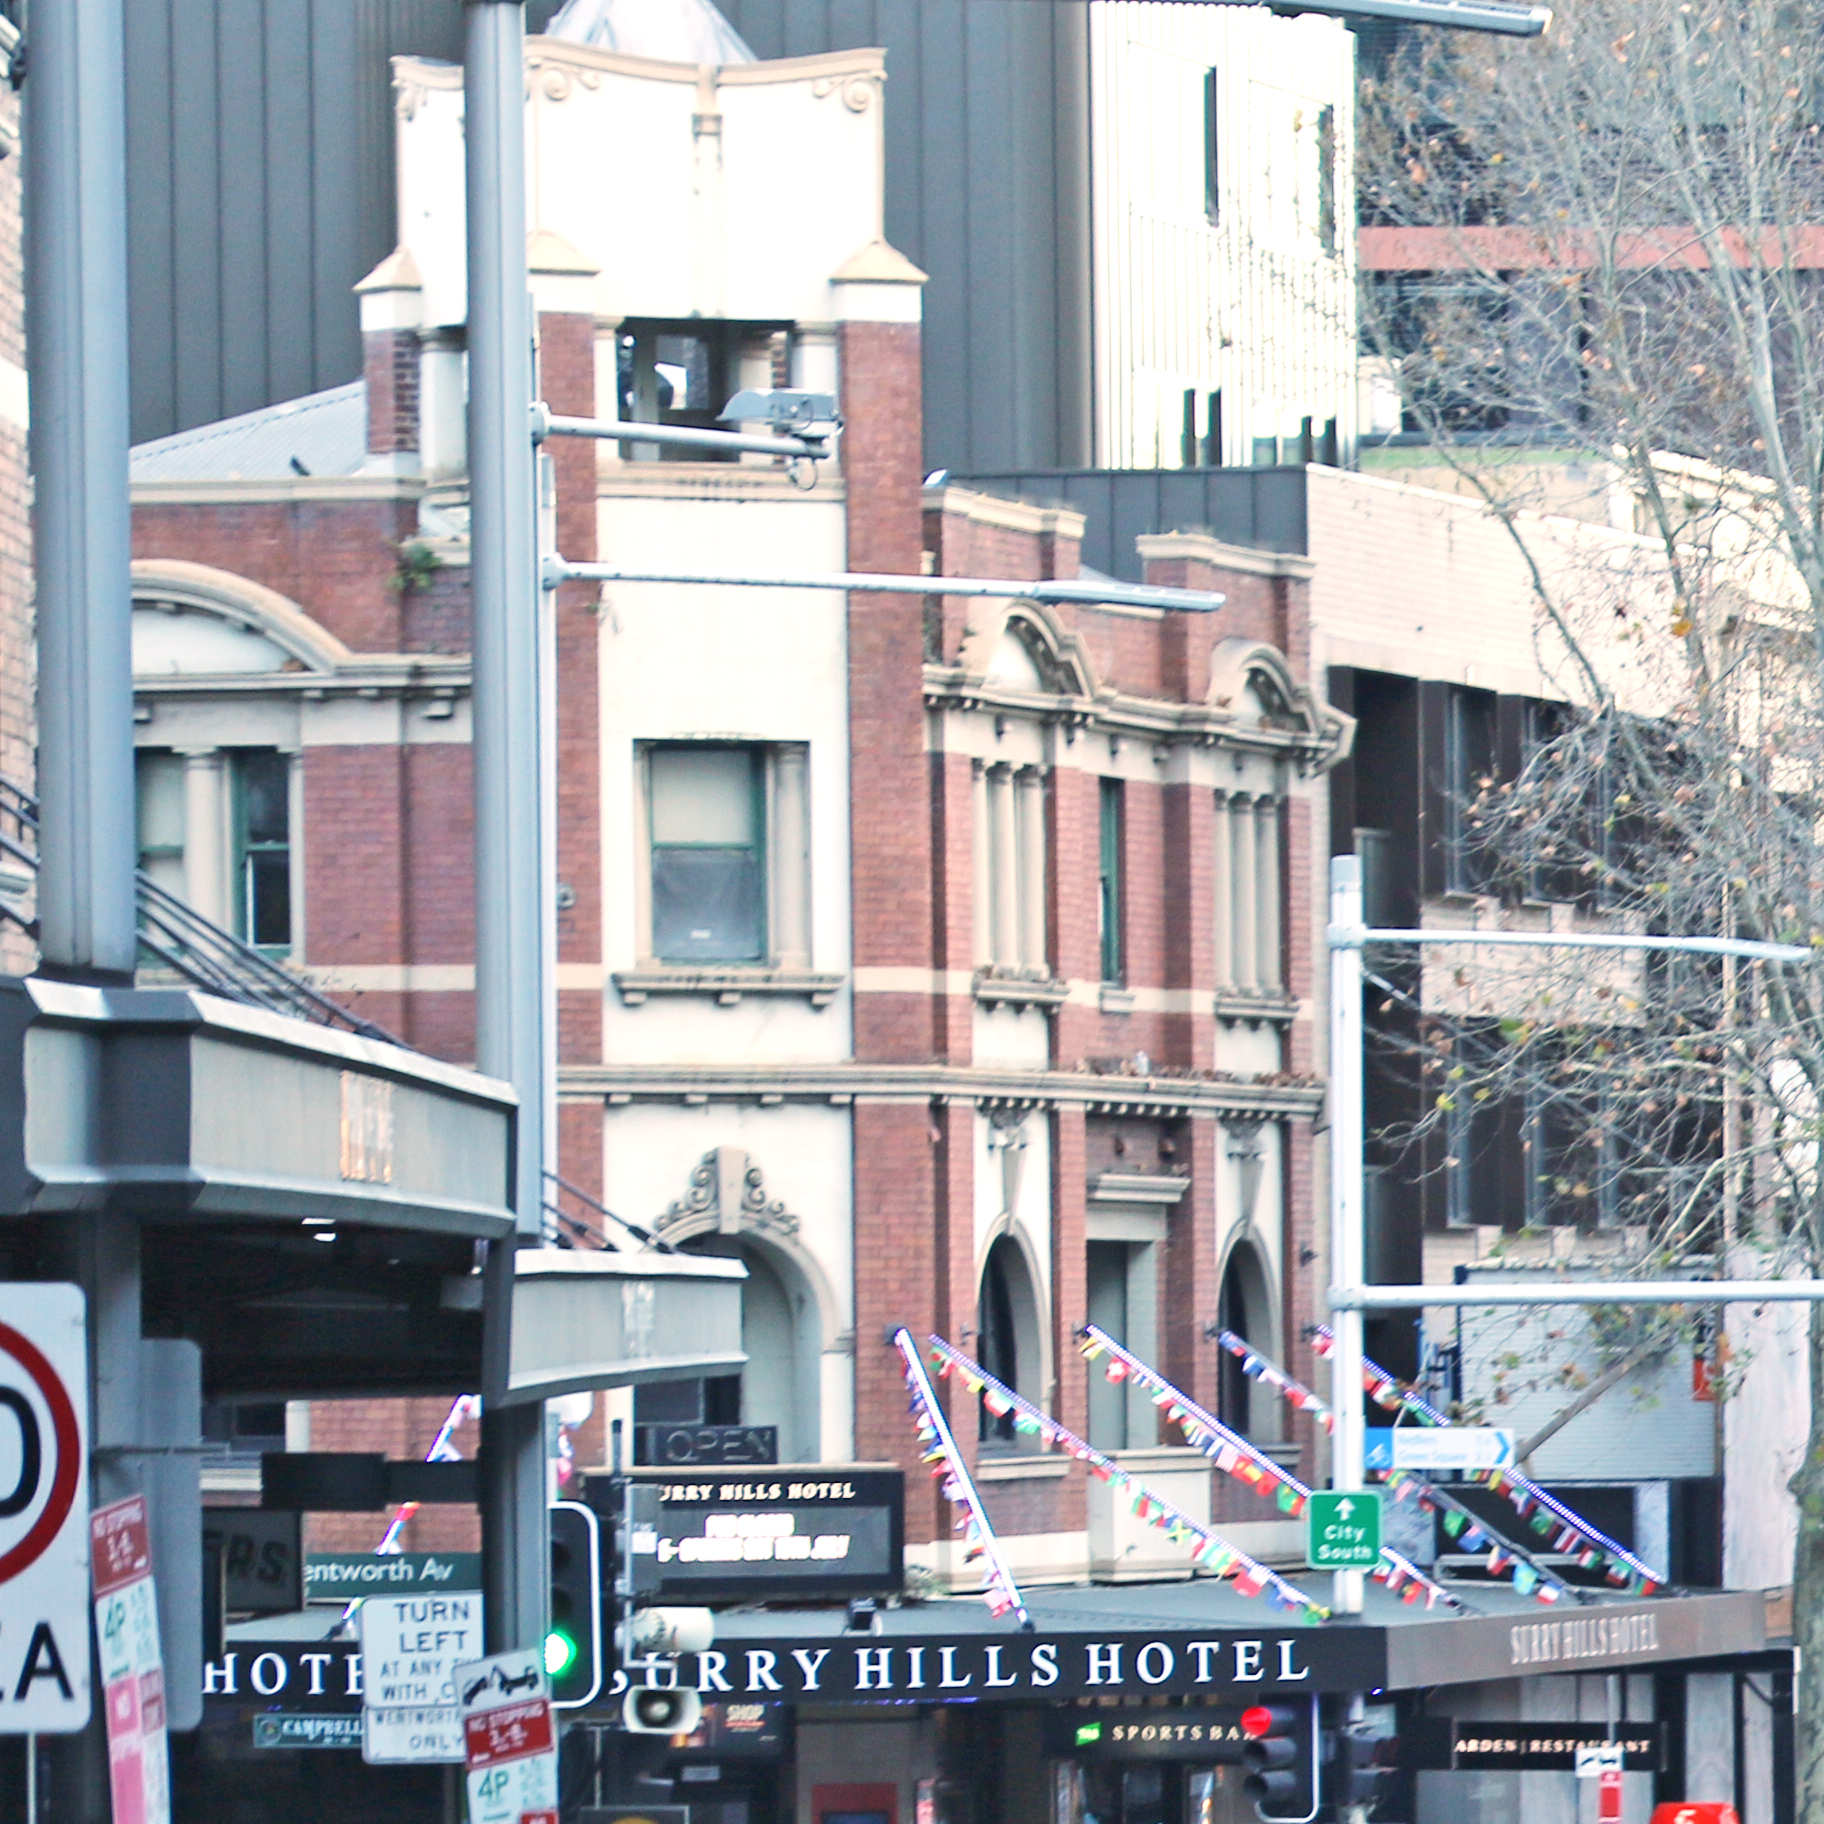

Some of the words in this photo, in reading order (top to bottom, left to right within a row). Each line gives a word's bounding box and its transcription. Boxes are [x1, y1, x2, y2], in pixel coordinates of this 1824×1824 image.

[665, 1430, 772, 1462] OPEN
[718, 1483, 782, 1501] HILLS
[787, 1482, 856, 1499] HOTEL
[1324, 1524, 1367, 1543] City
[1317, 1544, 1373, 1560] South
[303, 1559, 413, 1582] entworth
[418, 1558, 455, 1582] Av
[393, 1601, 470, 1623] TURN
[400, 1631, 469, 1653] LEFT
[202, 1652, 364, 1696] HOTE
[380, 1660, 399, 1678] AT
[408, 1660, 442, 1676] ANY
[609, 1648, 832, 1696] URRY
[853, 1642, 1060, 1691] HILLS
[1084, 1638, 1311, 1686] HOTEL
[382, 1682, 427, 1700] WITH
[409, 1734, 463, 1751] ONLY
[1110, 1724, 1202, 1743] SPORTS
[477, 1768, 510, 1800] 4P
